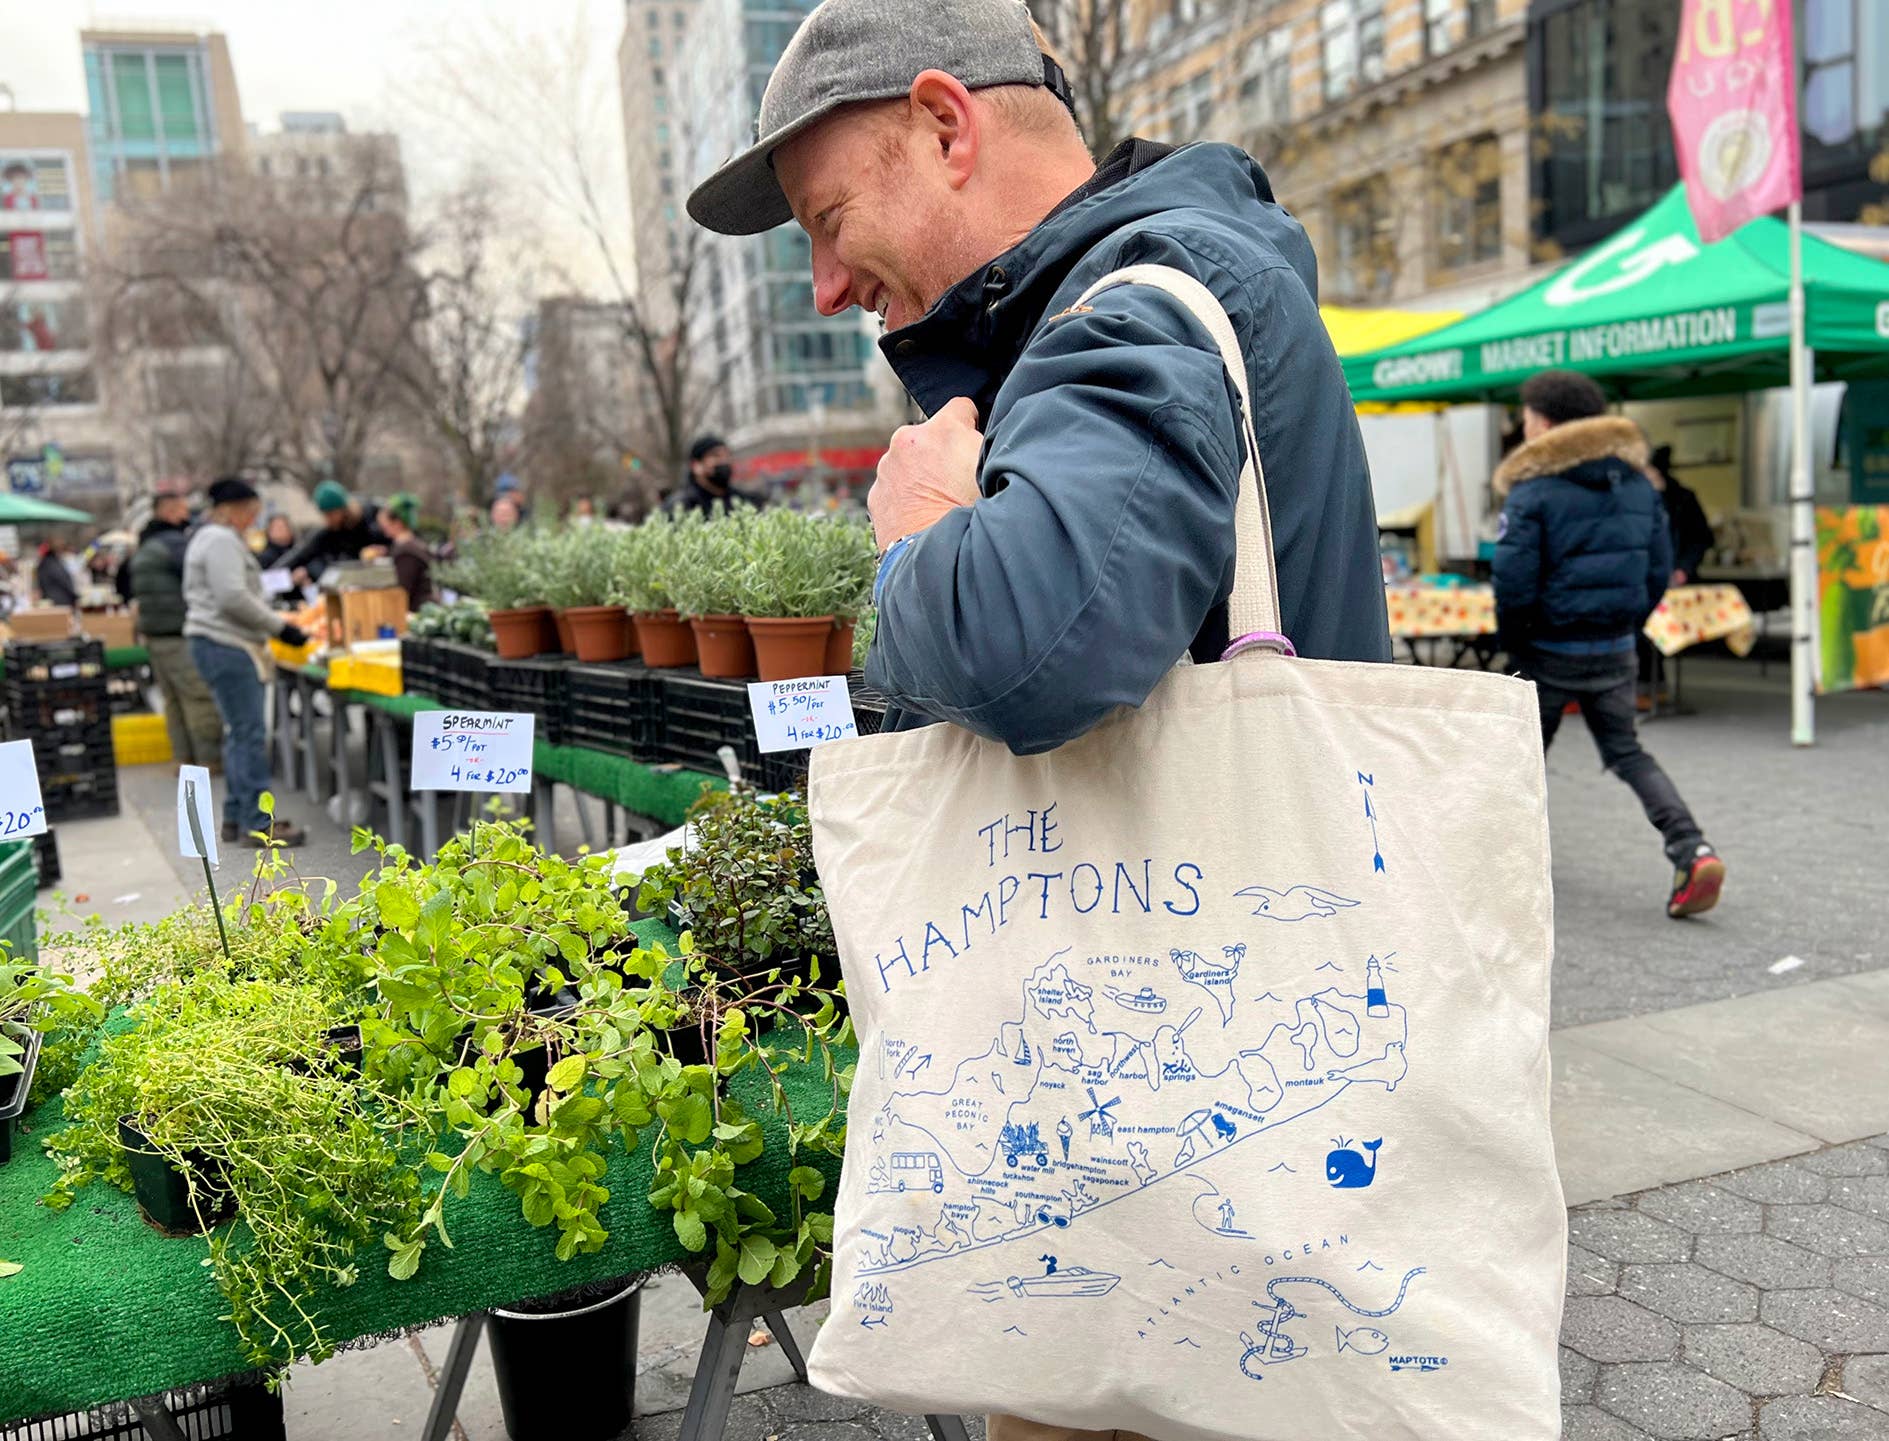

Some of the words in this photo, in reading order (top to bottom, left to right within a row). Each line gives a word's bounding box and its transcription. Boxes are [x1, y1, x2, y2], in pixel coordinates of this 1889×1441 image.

[1481, 330, 1566, 374] MARKET
[1569, 306, 1737, 362] INFORMATION
[772, 680, 831, 694] PEPPERMINT
[443, 715, 514, 730] SPEARMINT
[787, 725, 798, 742] 4
[451, 764, 460, 782] 4
[1357, 770, 1374, 786] N
[979, 801, 1064, 867] THE
[875, 859, 1204, 994] HAMPTONS
[1087, 957, 1160, 968] GARDINERS
[1111, 969, 1133, 978] BAY
[1189, 970, 1230, 980] gardiners
[1204, 977, 1231, 986] island
[1037, 988, 1065, 997] shelter
[1039, 996, 1063, 1005] island
[1053, 1037, 1075, 1046] north
[1053, 1046, 1076, 1054] haven
[1110, 1044, 1140, 1078] northwest
[1087, 1070, 1103, 1079] sag
[1119, 1071, 1148, 1080] harbor
[1163, 1072, 1196, 1082] springs
[1040, 1080, 1066, 1090] noyack
[1081, 1077, 1109, 1086] harbor
[1285, 1077, 1325, 1088] montauk
[952, 1099, 983, 1108] GREAT
[945, 1109, 989, 1123] PECONIC
[1214, 1100, 1266, 1124] amagansett
[956, 1122, 975, 1130] BAY
[1117, 1126, 1136, 1134] east
[1138, 1126, 1176, 1136] hampton
[1090, 1156, 1129, 1166] wainscott
[1021, 1164, 1041, 1173] water
[1041, 1166, 1055, 1175] mill
[1052, 1160, 1107, 1176] bridgehampton
[967, 1177, 1009, 1188] shinnecock
[1082, 1174, 1130, 1187] sagaponack
[980, 1187, 996, 1195] hills
[1015, 1190, 1063, 1203] southampton
[943, 1203, 976, 1213] hampton
[951, 1211, 969, 1220] bays
[1137, 1264, 1241, 1340] ATLANTIC
[1264, 1234, 1350, 1267] OCEAN
